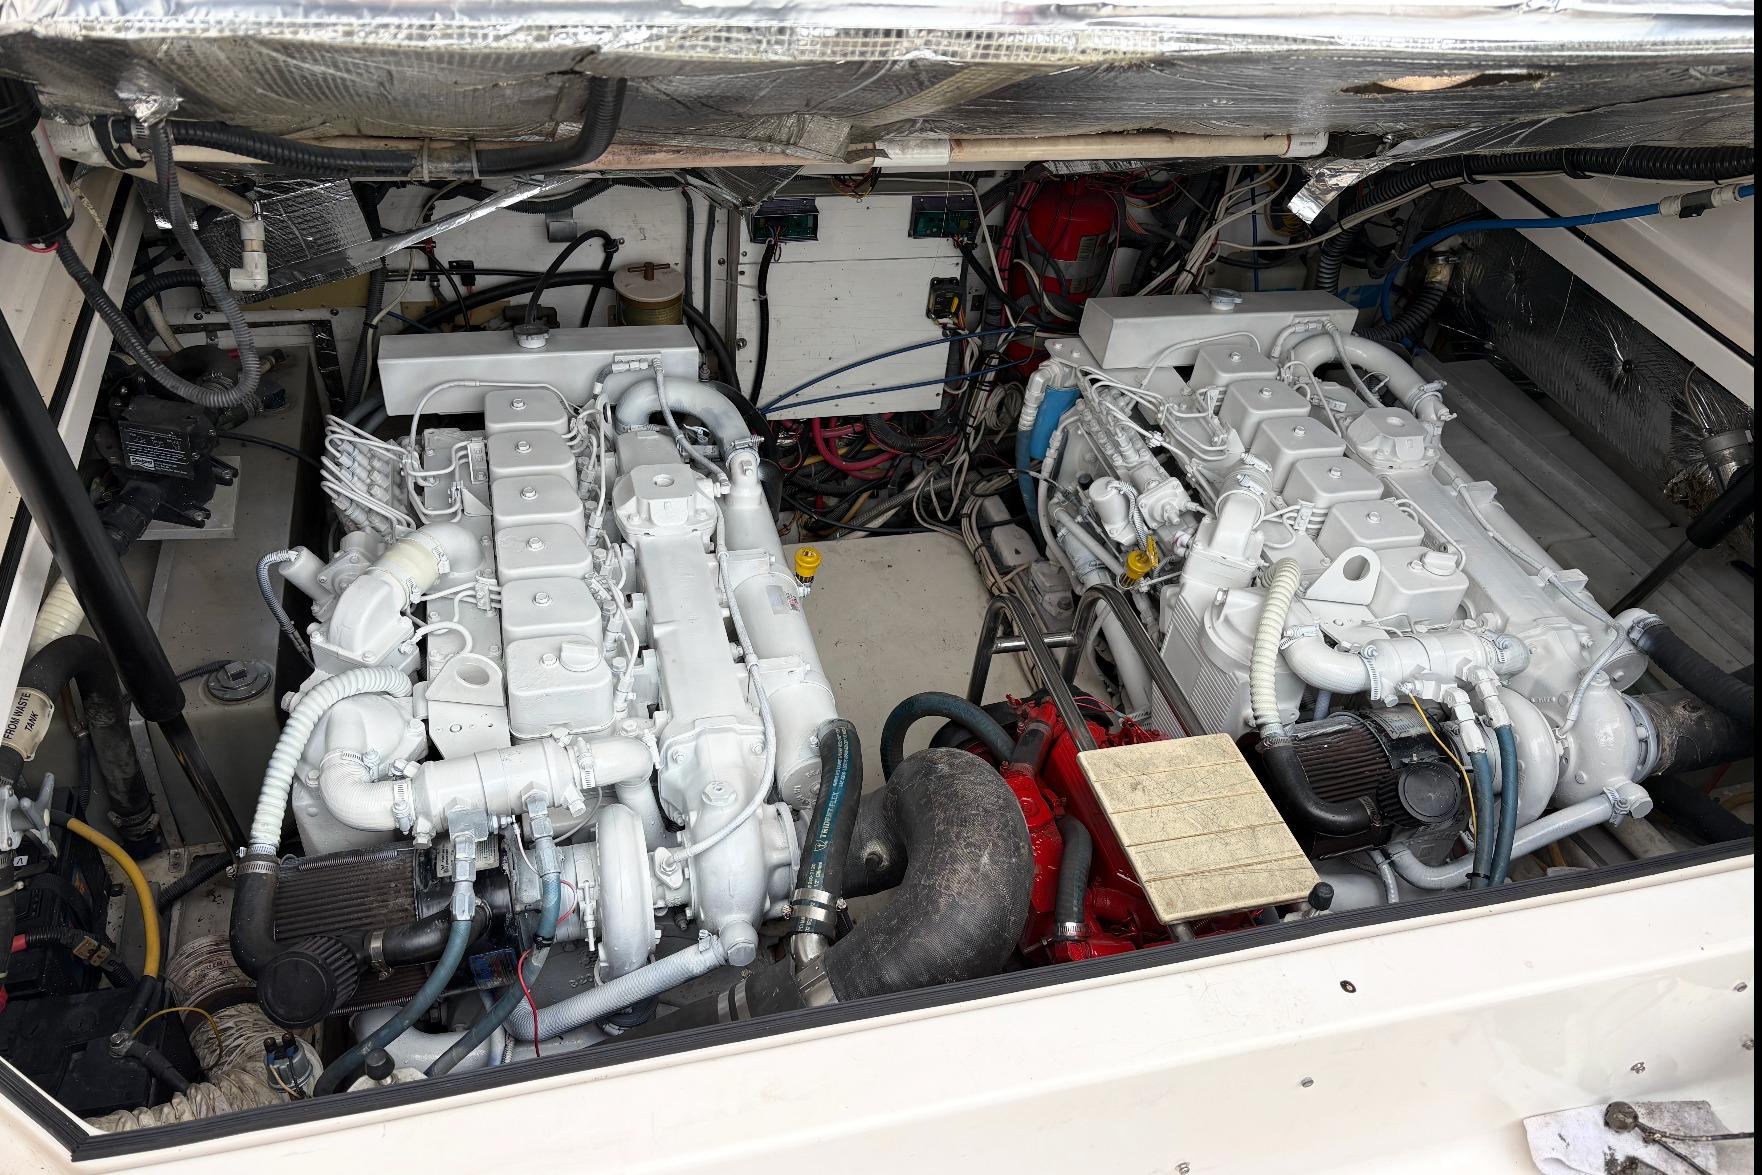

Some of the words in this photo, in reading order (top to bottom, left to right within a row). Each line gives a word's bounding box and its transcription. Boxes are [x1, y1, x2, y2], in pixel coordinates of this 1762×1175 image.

[3, 717, 20, 739] FROM
[13, 693, 31, 716] WASTE
[24, 711, 39, 732] TANK
